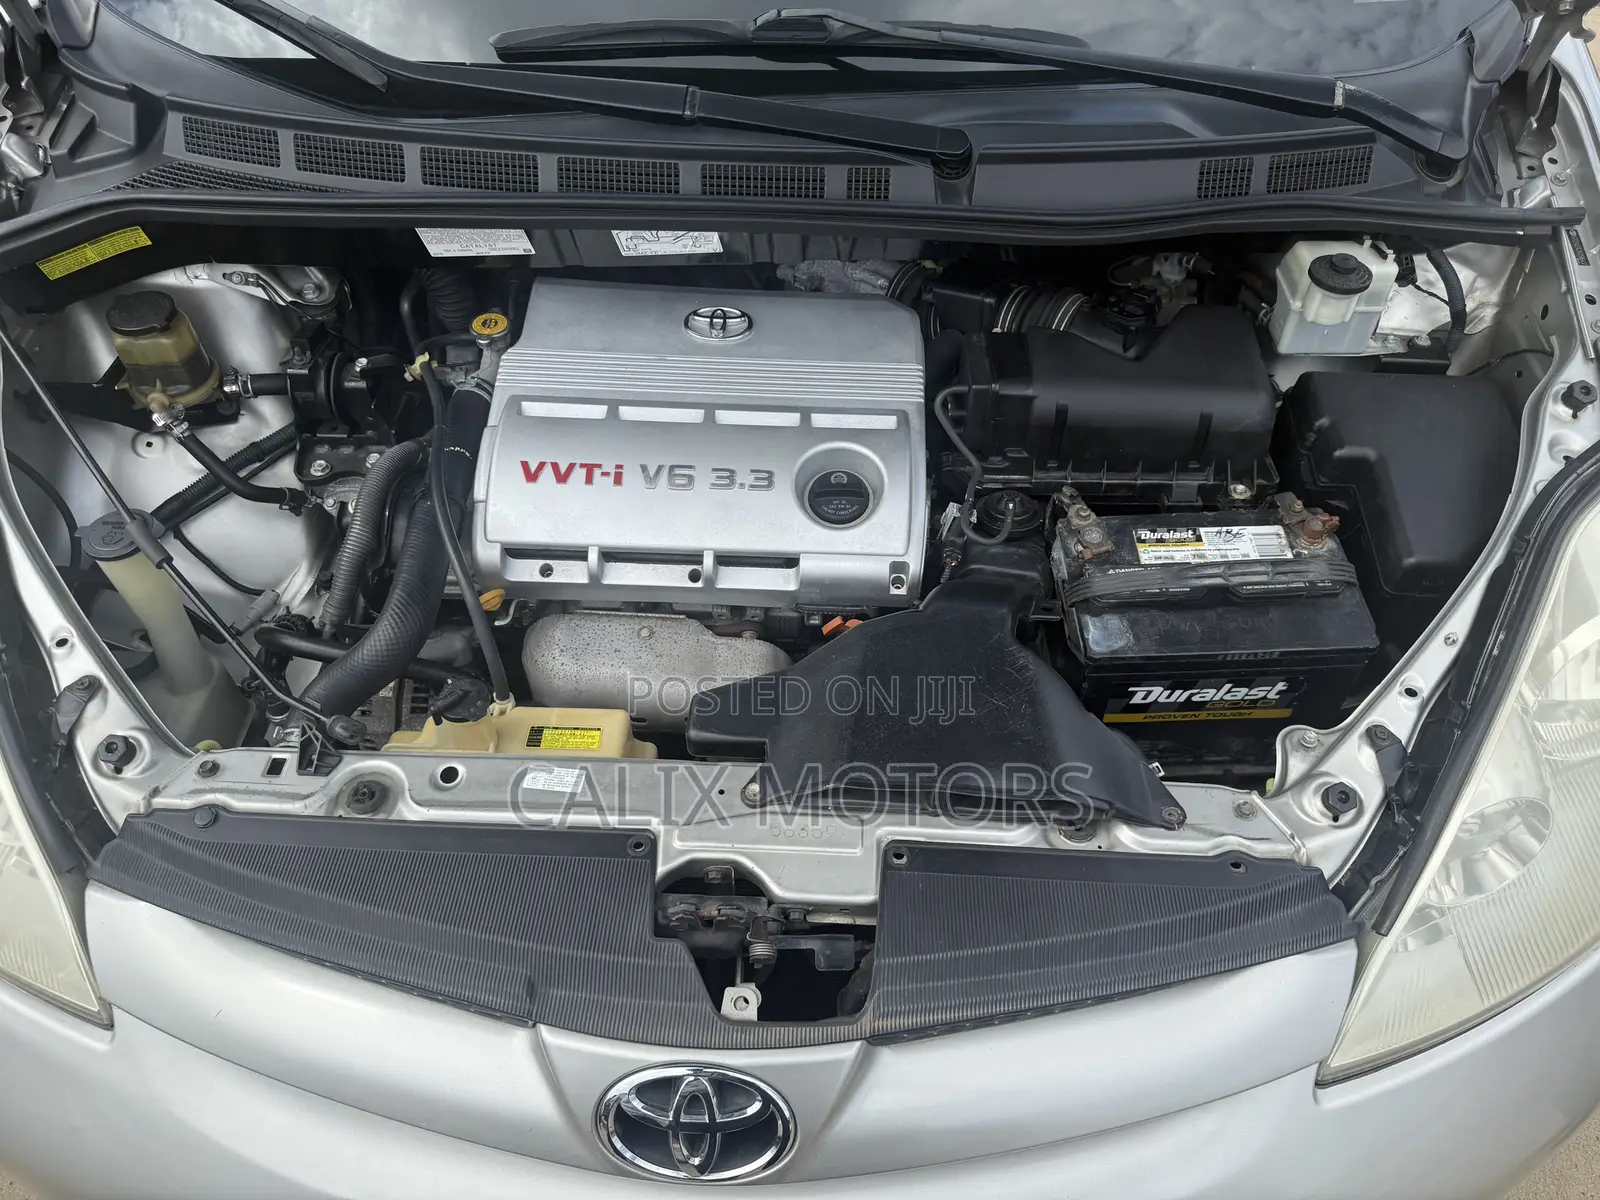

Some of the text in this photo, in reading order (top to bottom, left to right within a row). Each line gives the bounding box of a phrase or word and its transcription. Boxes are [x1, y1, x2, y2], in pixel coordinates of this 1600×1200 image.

[520, 460, 777, 492] VVT-i V6 3.3
[1137, 530, 1194, 540] Duralast
[1127, 681, 1290, 704] Duralast
[1206, 700, 1276, 708] GOLD
[1142, 713, 1201, 721] PROVEN
